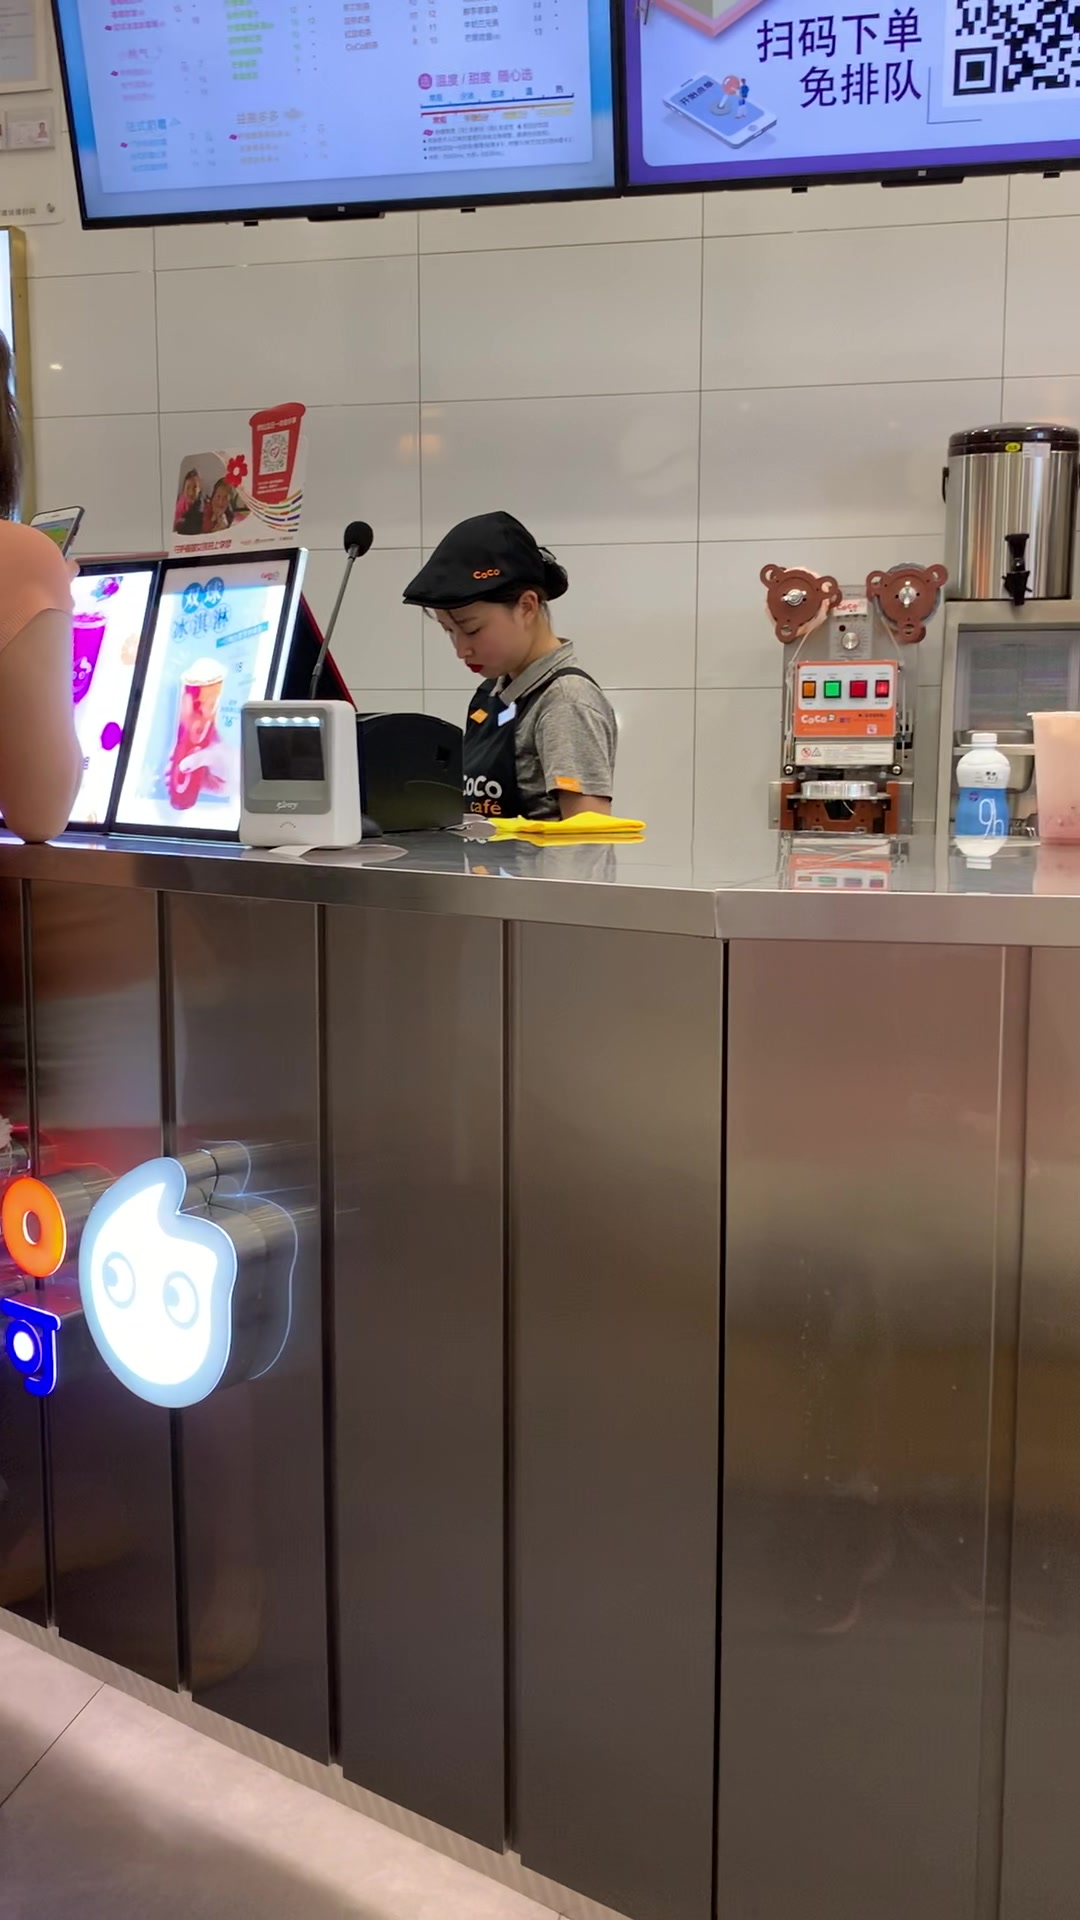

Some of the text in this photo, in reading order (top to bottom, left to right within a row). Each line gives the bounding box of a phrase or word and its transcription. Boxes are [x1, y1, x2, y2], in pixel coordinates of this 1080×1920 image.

[757, 7, 922, 63] 扫码下单
[799, 59, 922, 108] 免排队
[473, 569, 500, 579] CoCo
[183, 578, 223, 611] 双球
[172, 606, 230, 641] 冰淇淋
[470, 799, 502, 815] café
